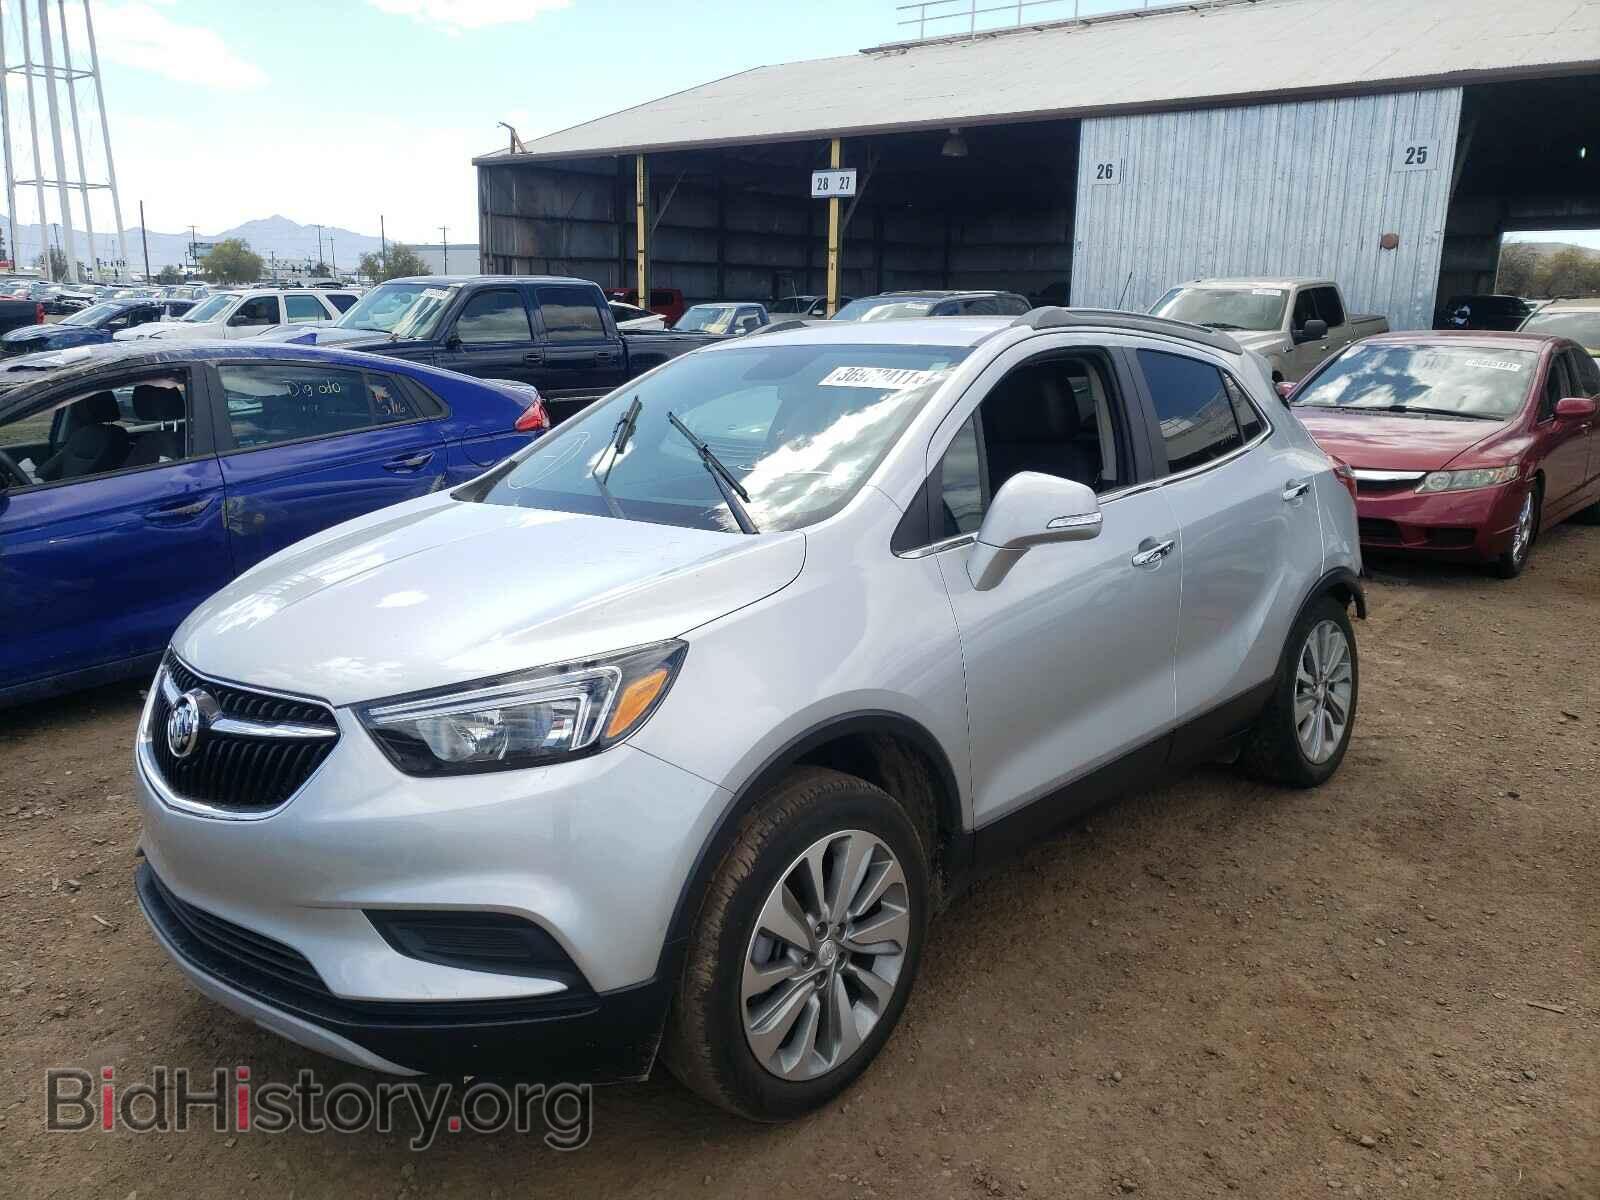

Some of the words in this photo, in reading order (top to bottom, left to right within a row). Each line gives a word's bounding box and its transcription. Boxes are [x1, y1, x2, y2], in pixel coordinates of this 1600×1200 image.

[1404, 146, 1428, 165] 25
[1096, 163, 1113, 180] 26
[817, 177, 829, 191] 28
[839, 176, 850, 190] 27
